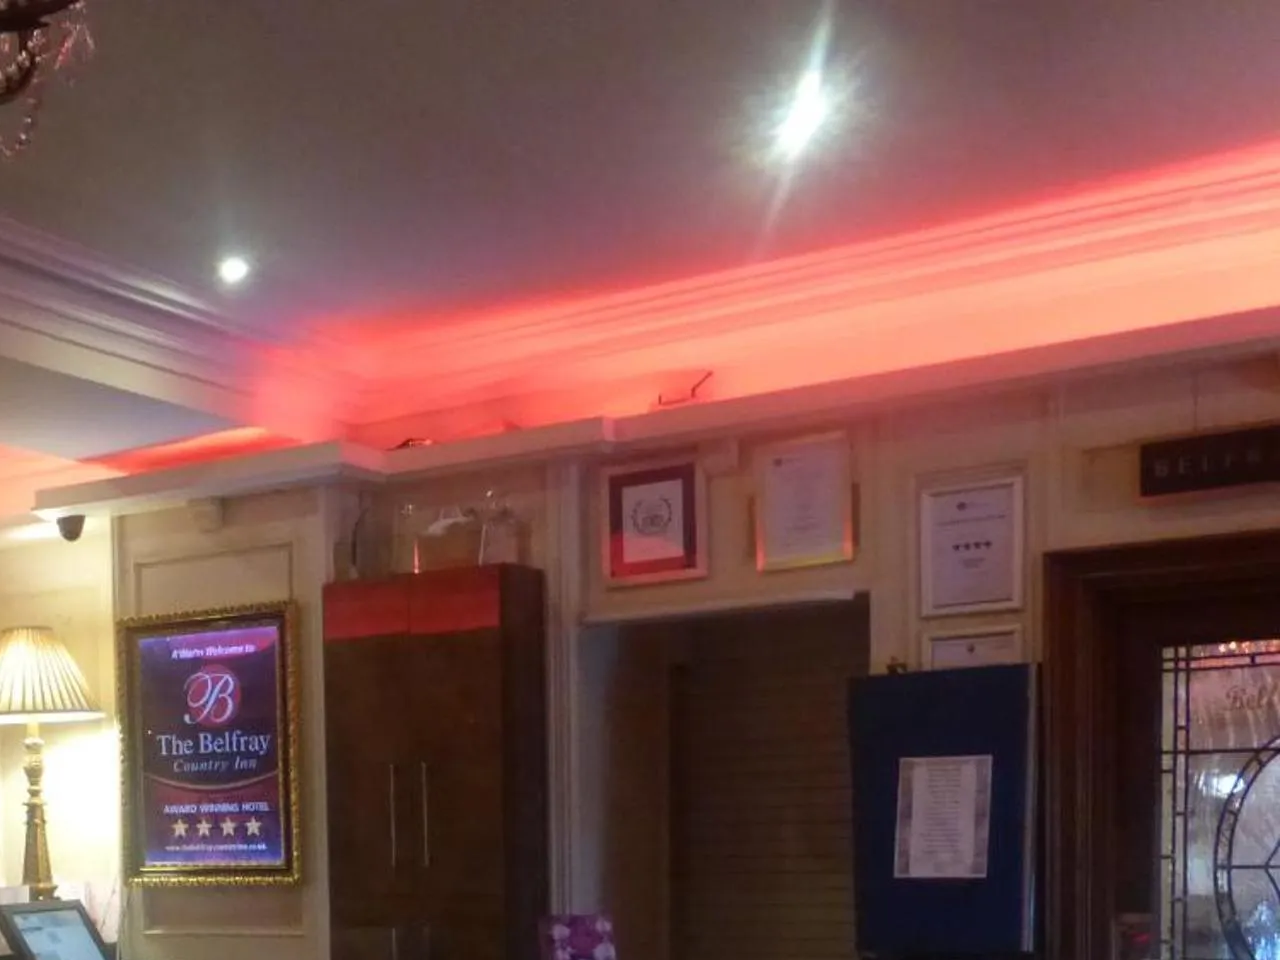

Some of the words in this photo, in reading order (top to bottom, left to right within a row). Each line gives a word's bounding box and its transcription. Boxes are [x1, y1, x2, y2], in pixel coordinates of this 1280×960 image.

[156, 734, 194, 756] The
[198, 731, 271, 756] Belfray
[173, 759, 230, 773] Country
[235, 756, 257, 769] Inn
[163, 804, 197, 815] AWARD
[200, 802, 239, 814] WINNING
[242, 801, 269, 812] HOTEL
